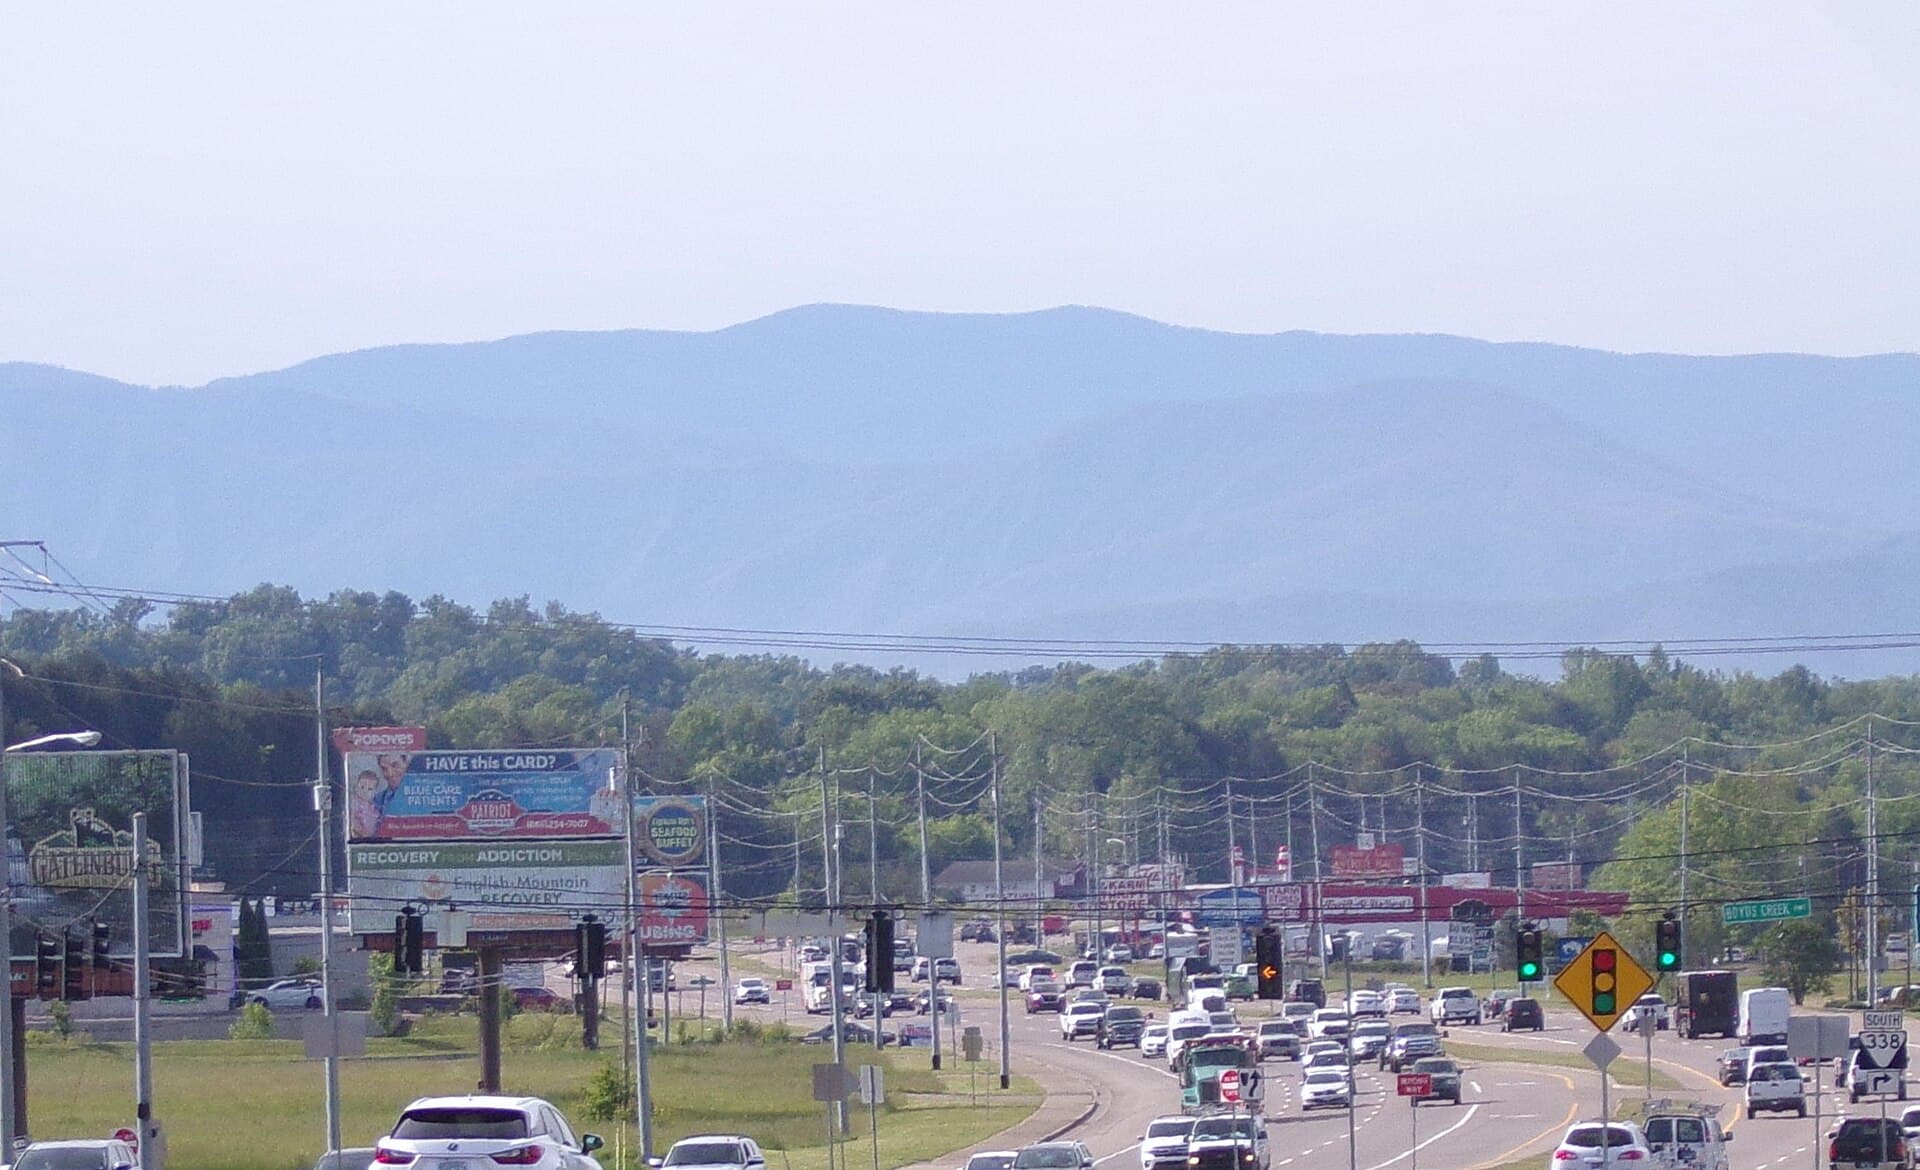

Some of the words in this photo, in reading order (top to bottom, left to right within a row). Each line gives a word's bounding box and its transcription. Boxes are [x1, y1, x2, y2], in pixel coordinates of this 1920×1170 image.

[425, 756, 468, 770] HAVE
[471, 755, 500, 769] this
[503, 755, 556, 769] CARD?
[434, 784, 462, 795] CARE
[408, 796, 457, 806] PATIENTS
[471, 803, 511, 819] PATRIOT
[651, 827, 697, 837] SEAFOOD
[656, 838, 692, 849] BUFFET
[357, 851, 440, 864] RECOVERY
[476, 849, 563, 862] ADDICTION
[31, 852, 159, 885] GATLINBUG
[454, 876, 509, 893] English
[518, 875, 589, 890] Mountain
[1761, 902, 1790, 916] CREEK
[1866, 1014, 1900, 1026] SOUTH
[1865, 1034, 1900, 1049] 338
